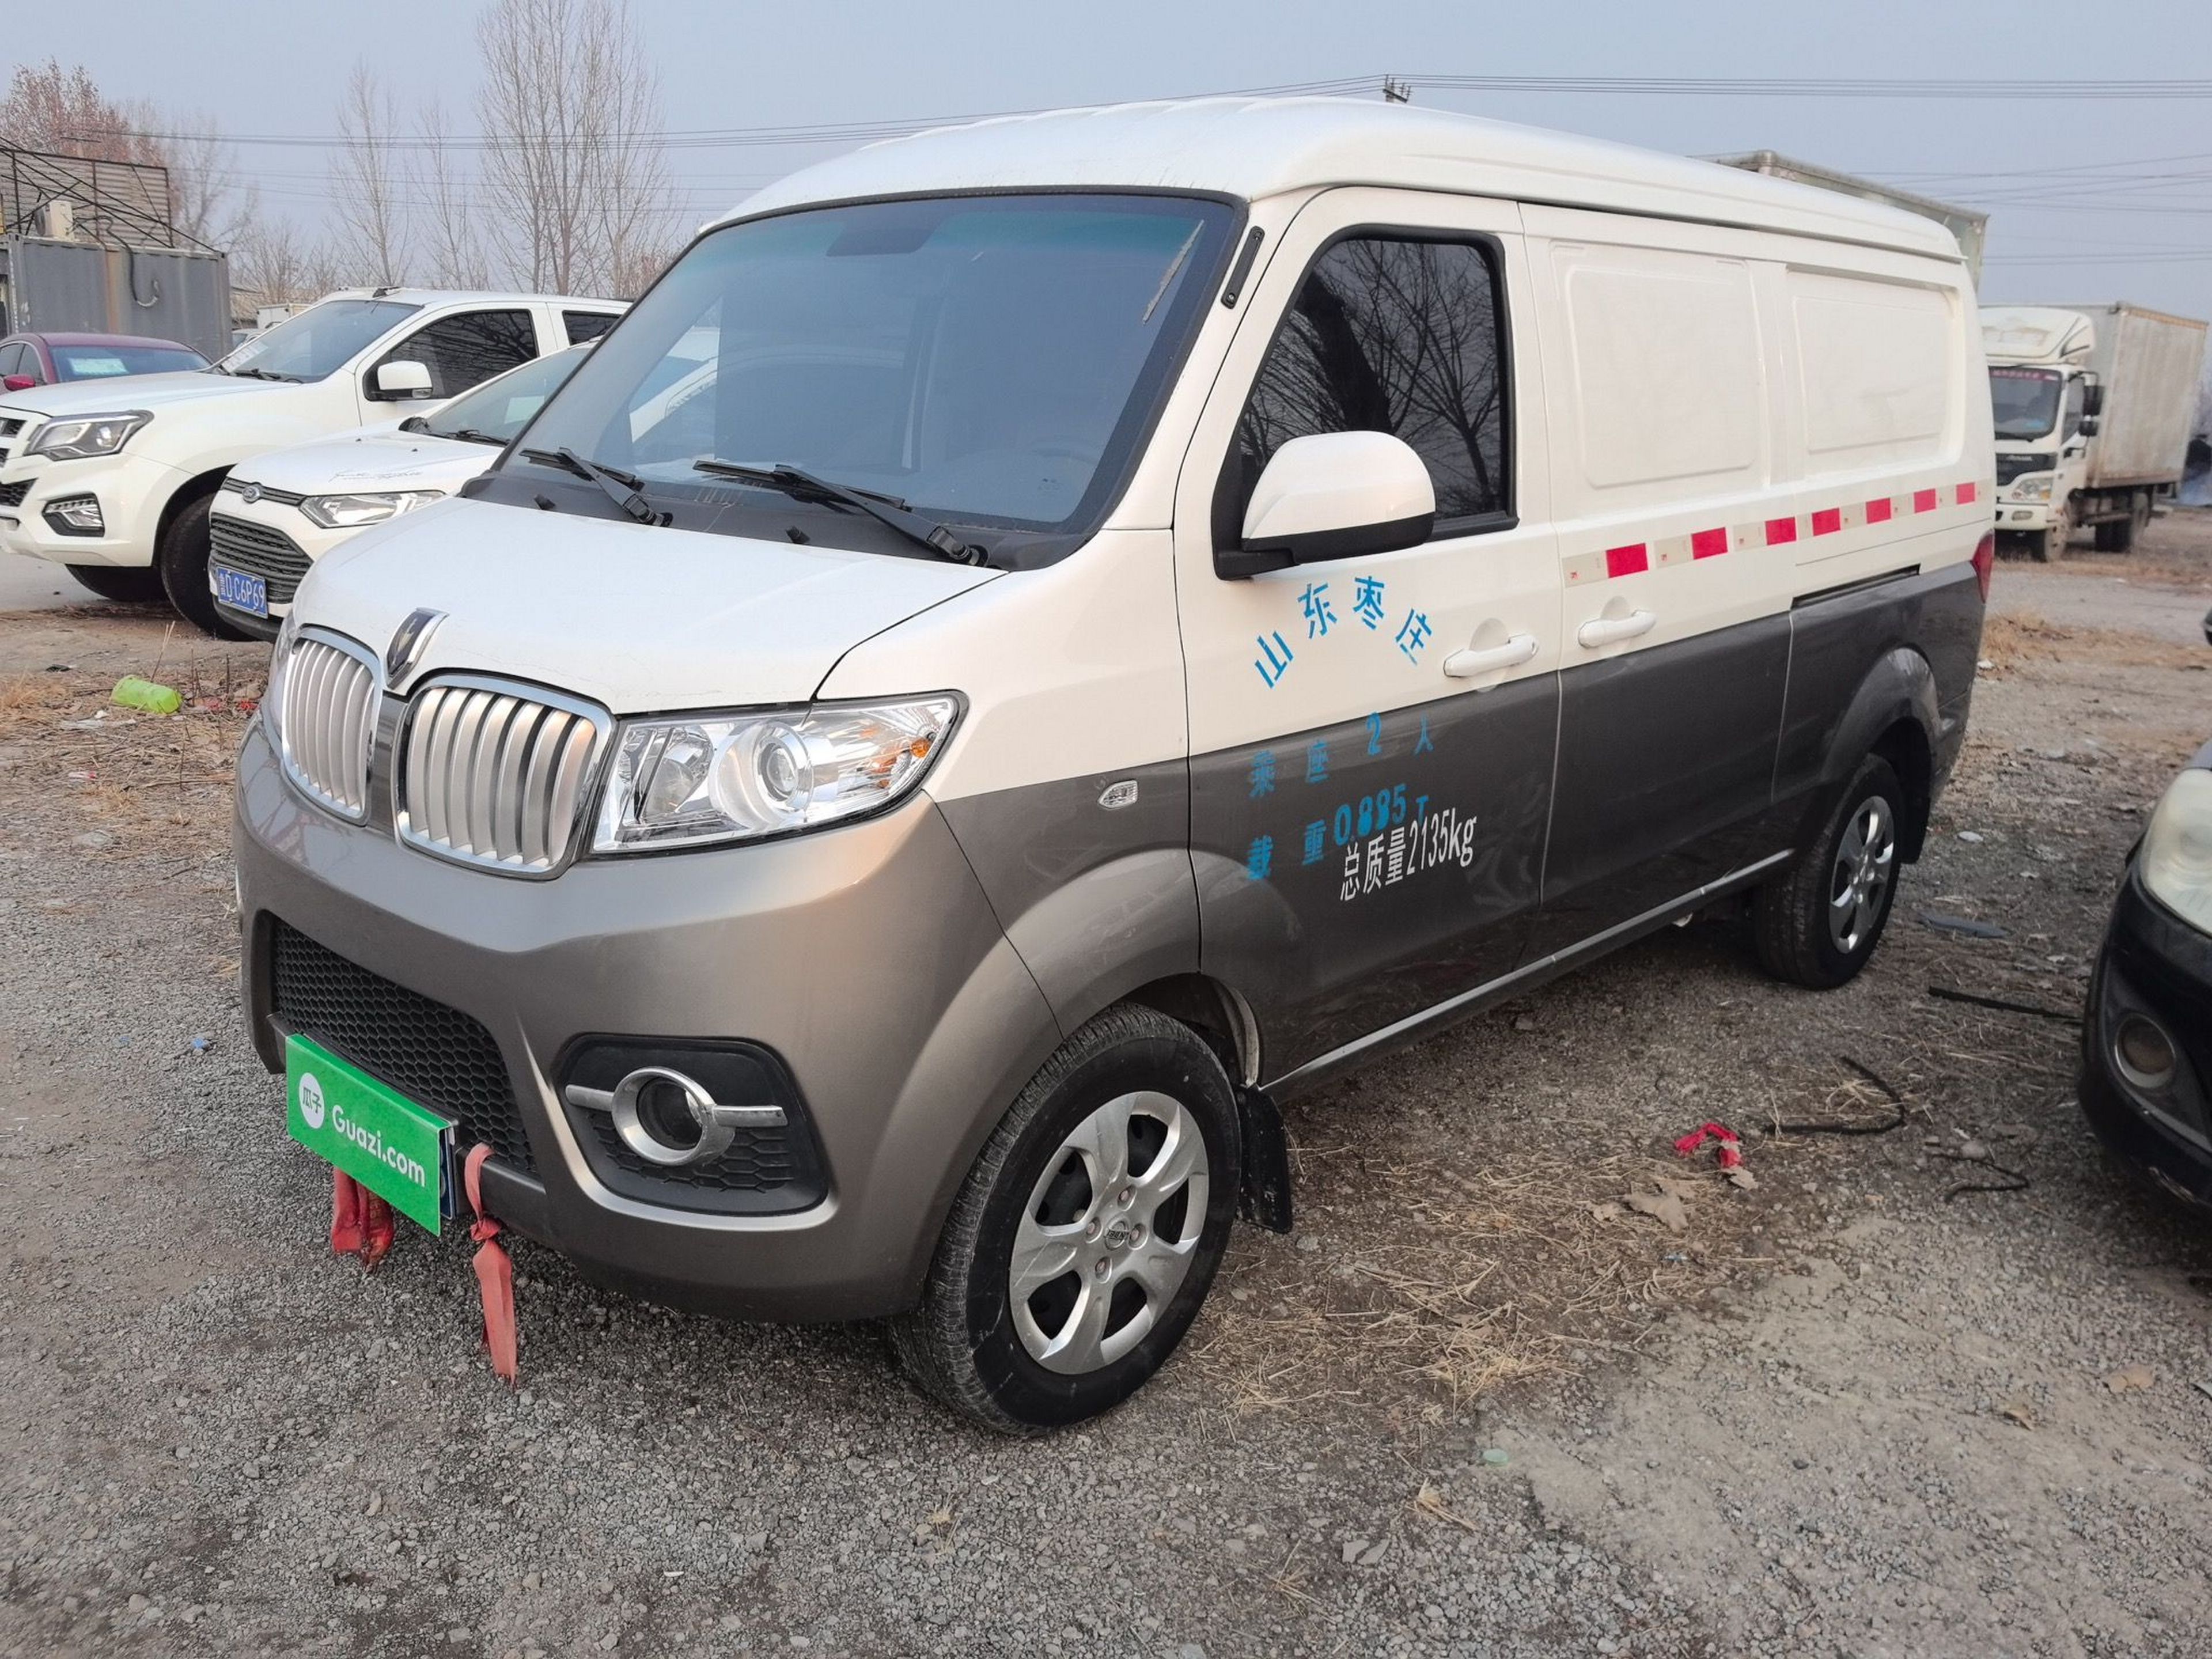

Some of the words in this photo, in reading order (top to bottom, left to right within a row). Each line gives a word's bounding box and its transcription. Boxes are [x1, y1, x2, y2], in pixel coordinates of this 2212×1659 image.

[1254, 575, 1433, 689] 山东枣庄
[1340, 808, 1477, 902] 总质量2135kg
[302, 1087, 322, 1114] 瓜子
[332, 1105, 425, 1188] Guazi.com
